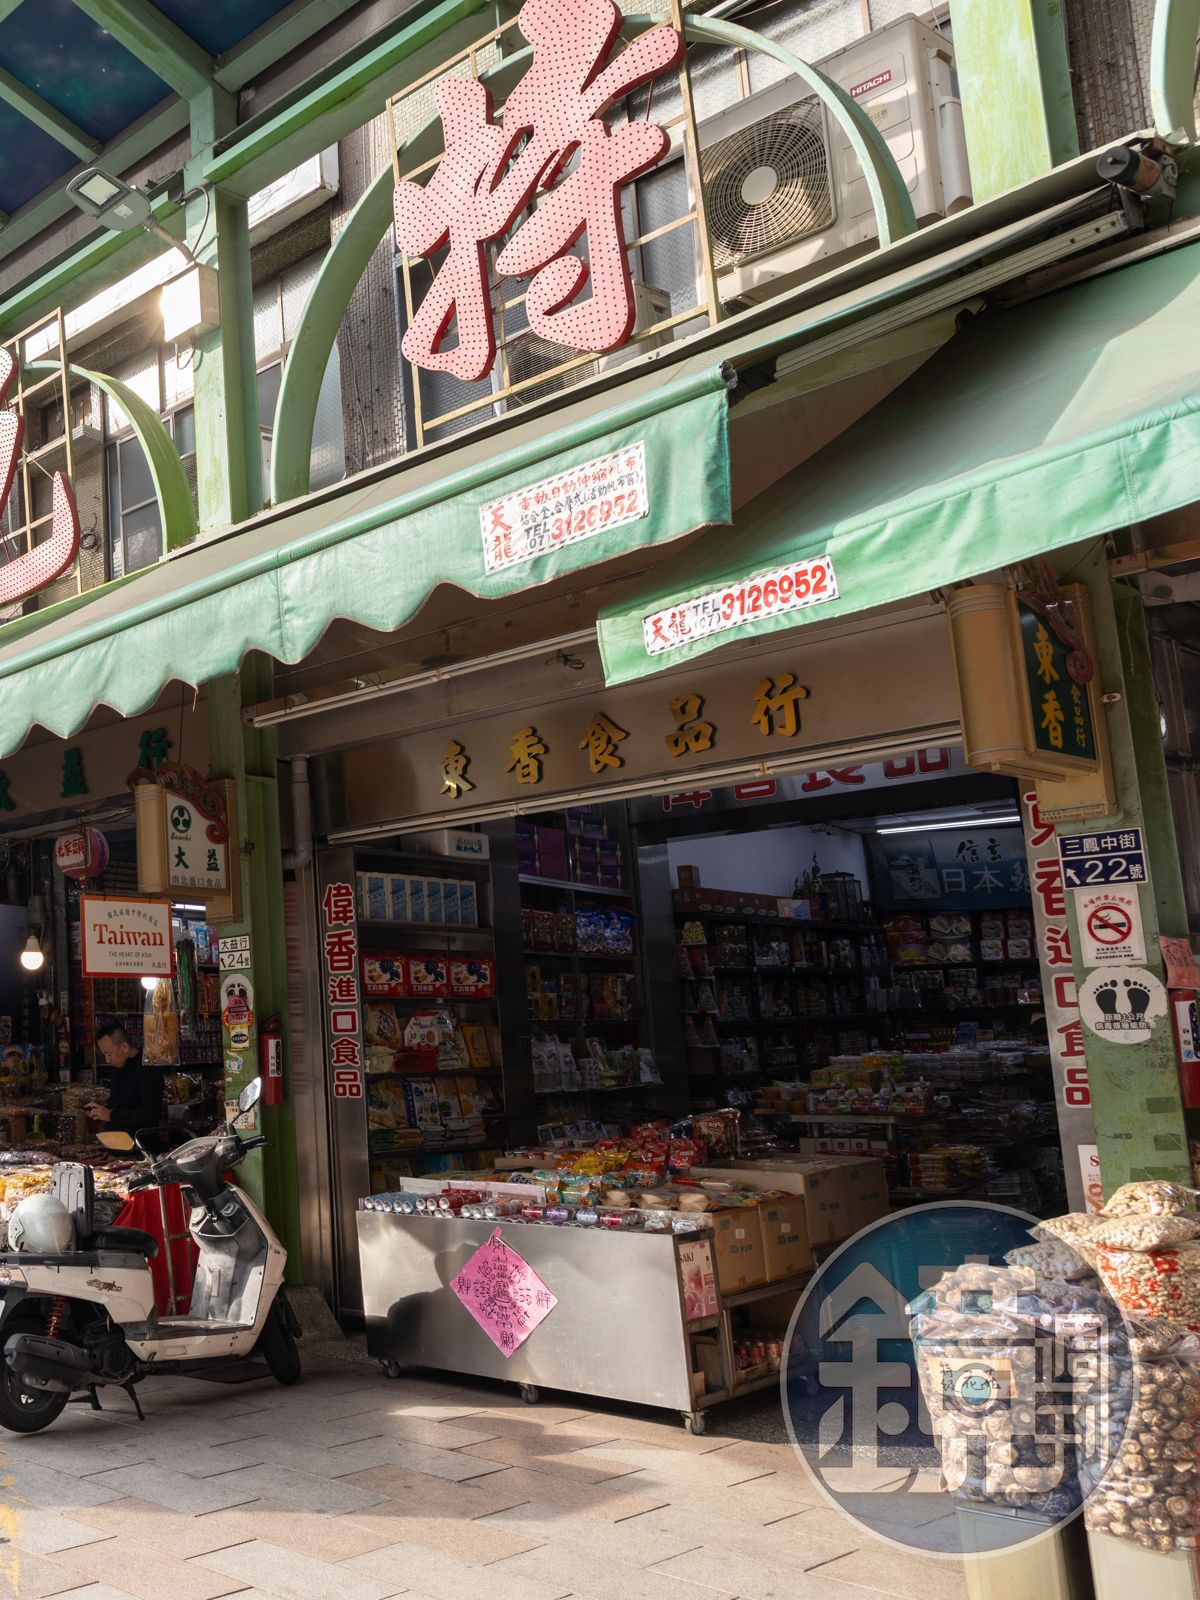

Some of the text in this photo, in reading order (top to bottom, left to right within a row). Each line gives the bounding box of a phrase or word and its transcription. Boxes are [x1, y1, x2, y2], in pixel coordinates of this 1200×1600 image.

[851, 73, 890, 97] HITACHI
[490, 504, 518, 562] 天龍
[524, 489, 639, 541] TEL 3126952
[721, 564, 828, 621] 3126952
[651, 609, 692, 645] 天龍
[1032, 622, 1065, 750] 東香
[438, 671, 813, 799] 東香食品行
[1064, 833, 1137, 855] 三鳳中街
[1084, 857, 1144, 884] 22號
[93, 923, 165, 946] Taiwan
[221, 935, 249, 951] 大益行
[322, 883, 364, 1099] 偉香進口食品
